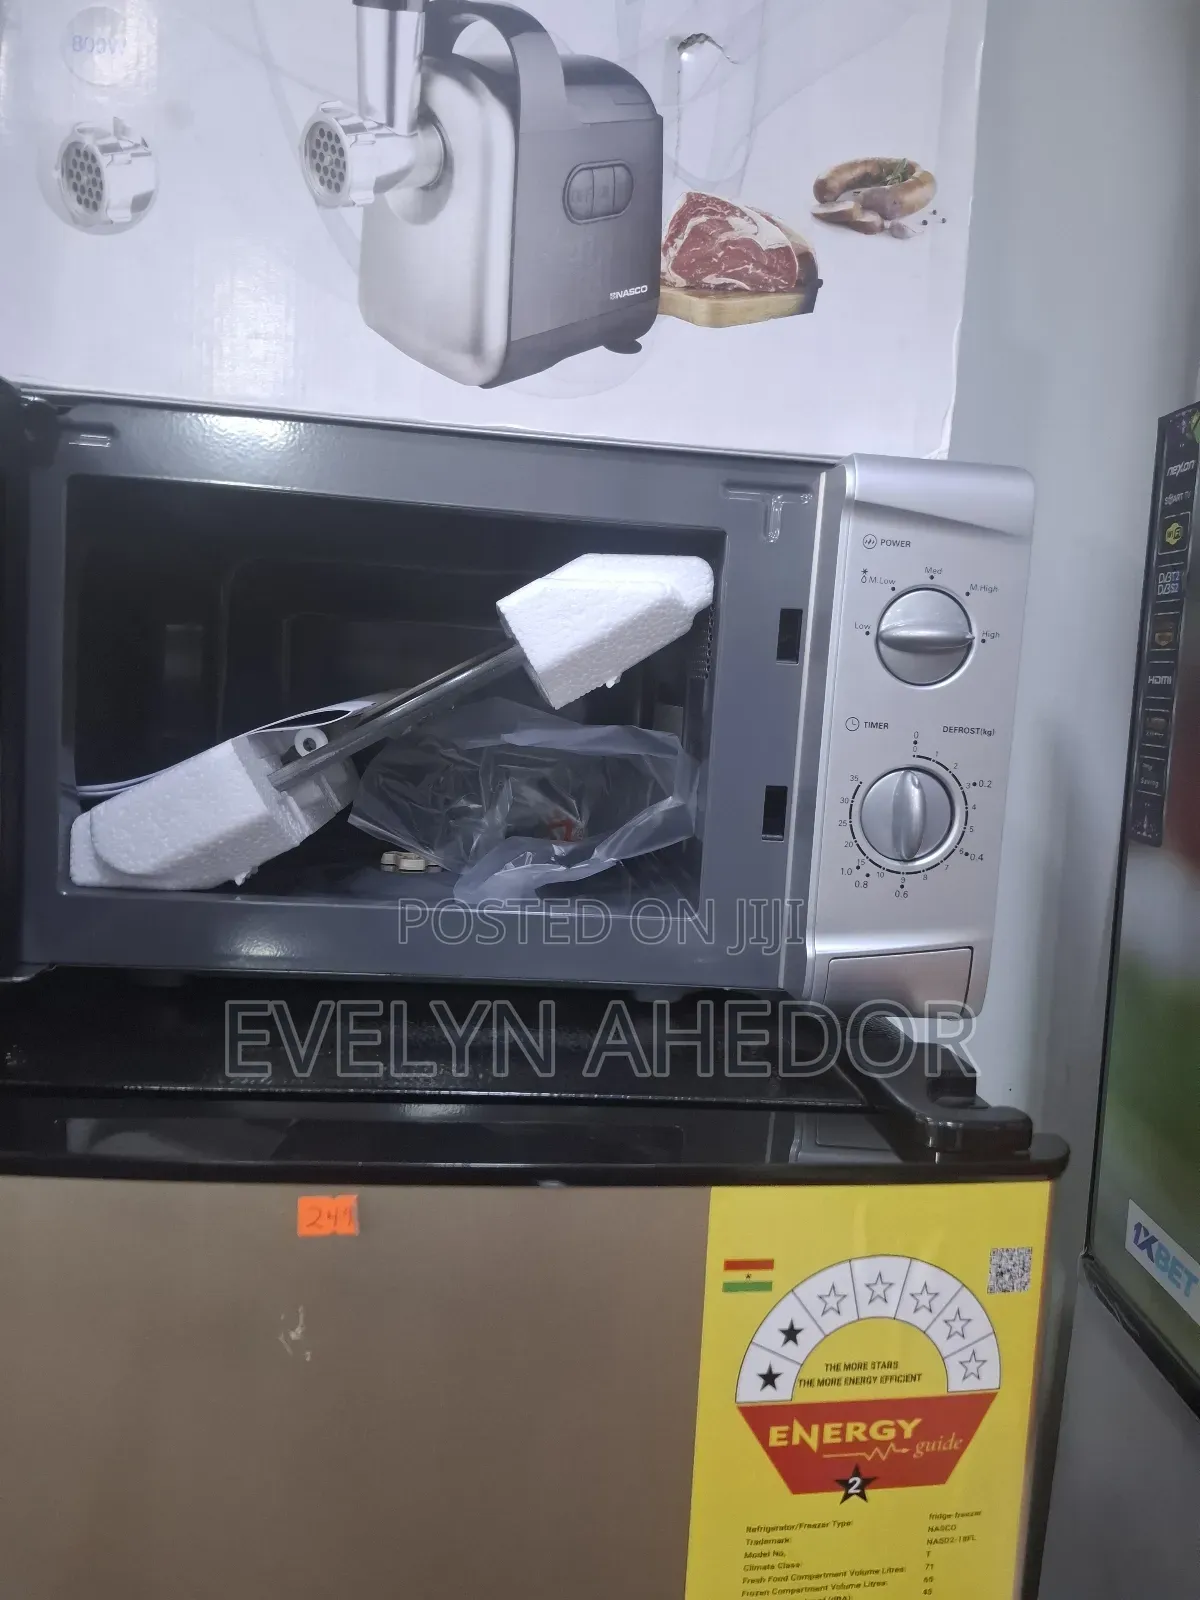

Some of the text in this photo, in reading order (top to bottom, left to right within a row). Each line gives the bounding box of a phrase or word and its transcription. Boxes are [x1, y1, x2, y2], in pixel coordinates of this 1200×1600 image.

[616, 285, 648, 299] NASCO
[880, 539, 911, 548] POWER
[924, 566, 943, 575] Med
[868, 576, 896, 585] M.Low
[969, 584, 999, 593] M.High
[854, 622, 871, 630] Low
[981, 630, 1000, 640] High
[1148, 675, 1172, 685] HDMI
[864, 721, 889, 730] TIMER
[914, 731, 919, 739] 0
[942, 725, 995, 737] DEFROST(kg)
[978, 780, 992, 788] 0.2
[970, 853, 984, 861] 0.4
[854, 880, 868, 888] 0.8
[895, 890, 909, 898] 0.6
[1133, 1221, 1199, 1298] 1XBET
[825, 1360, 899, 1372] THE MORE STARS
[798, 1374, 922, 1388] THE MORE ENERGY EFFICIENT
[769, 1416, 922, 1452] ENERGY
[913, 1432, 963, 1458] guide
[847, 1477, 861, 1494] 2
[927, 1524, 957, 1532] NASCO
[743, 1564, 775, 1572] Climate
[742, 1576, 766, 1584] Fresh
[768, 1574, 789, 1582] Food
[790, 1570, 847, 1581] Compartment
[849, 1567, 880, 1577] Volume
[772, 1585, 828, 1595] Compartment
[831, 1582, 861, 1590] Volume
